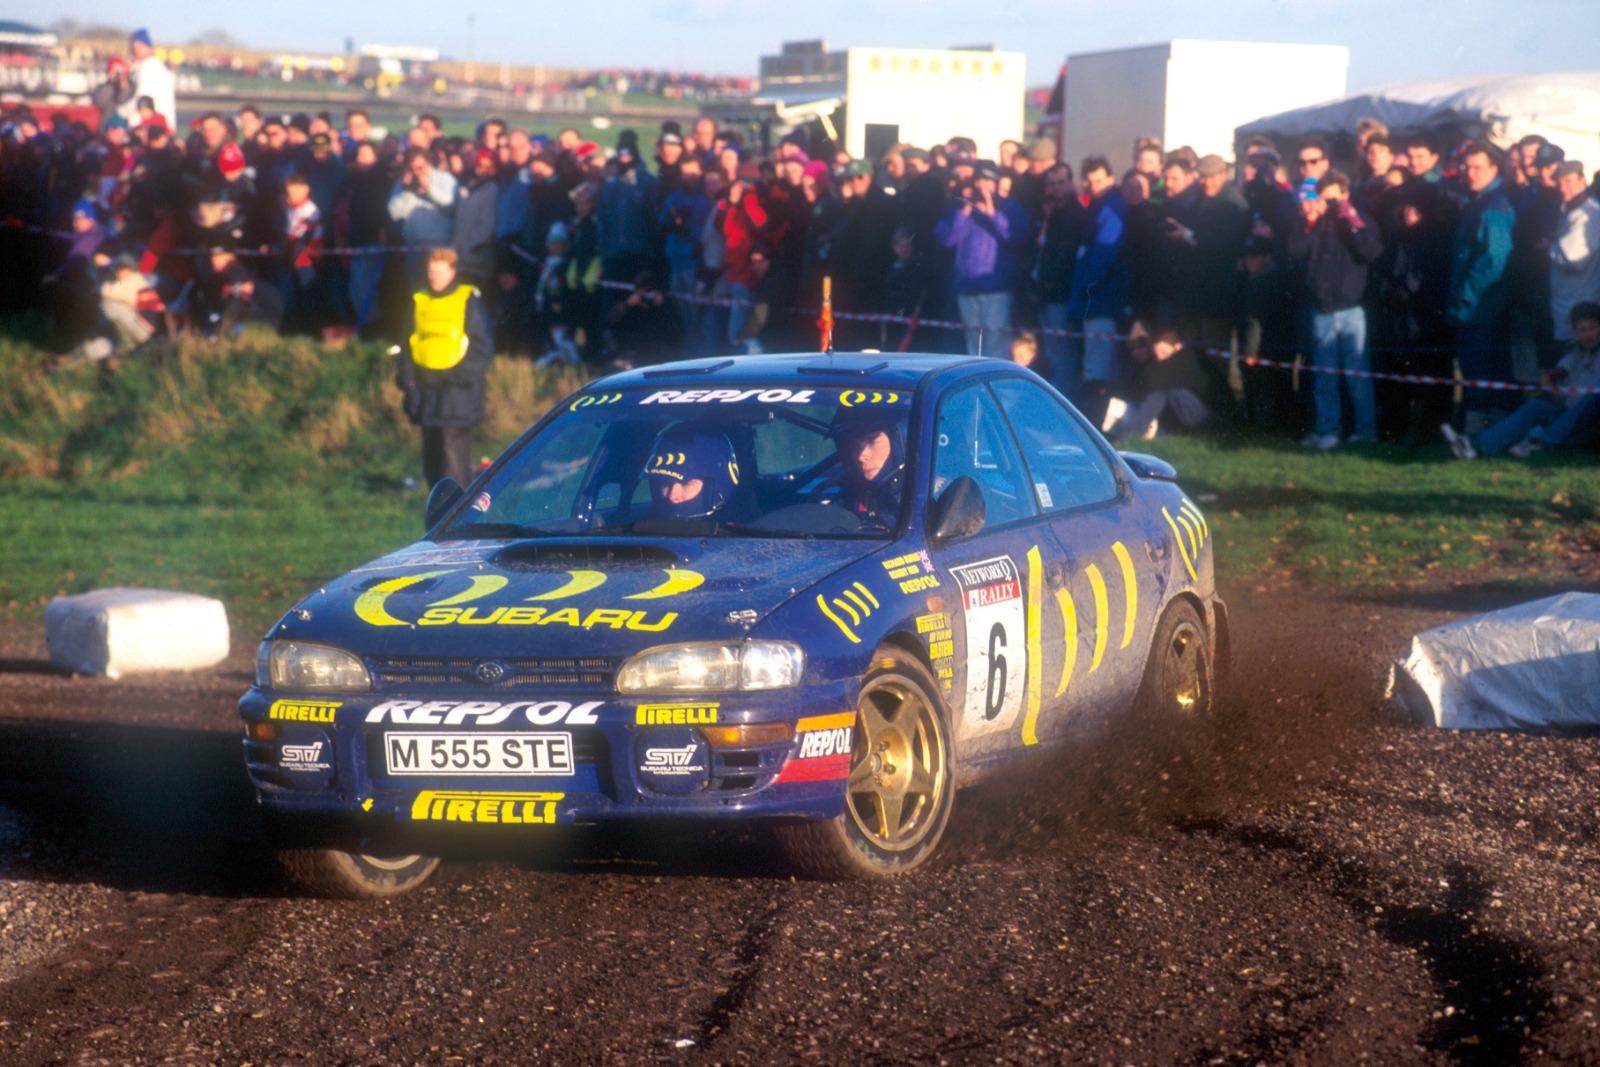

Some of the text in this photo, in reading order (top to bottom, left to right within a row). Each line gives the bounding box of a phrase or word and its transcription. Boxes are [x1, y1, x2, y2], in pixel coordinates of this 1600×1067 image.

[639, 389, 816, 404] REPSOL
[651, 469, 684, 480] SUBARU
[899, 574, 941, 595] REPSOL
[960, 563, 1004, 586] NETWORK
[980, 583, 1014, 607] RALLY
[417, 607, 679, 632] SUBARU
[915, 612, 945, 634] PIRELLI
[985, 621, 1008, 721] 6
[269, 699, 343, 723] PIRELLI
[365, 700, 606, 725] REPSOL
[636, 702, 720, 725] PIRELLI
[391, 739, 568, 769] M 555 STE
[799, 727, 851, 759] REPSOL
[411, 790, 565, 824] PIRELLI
